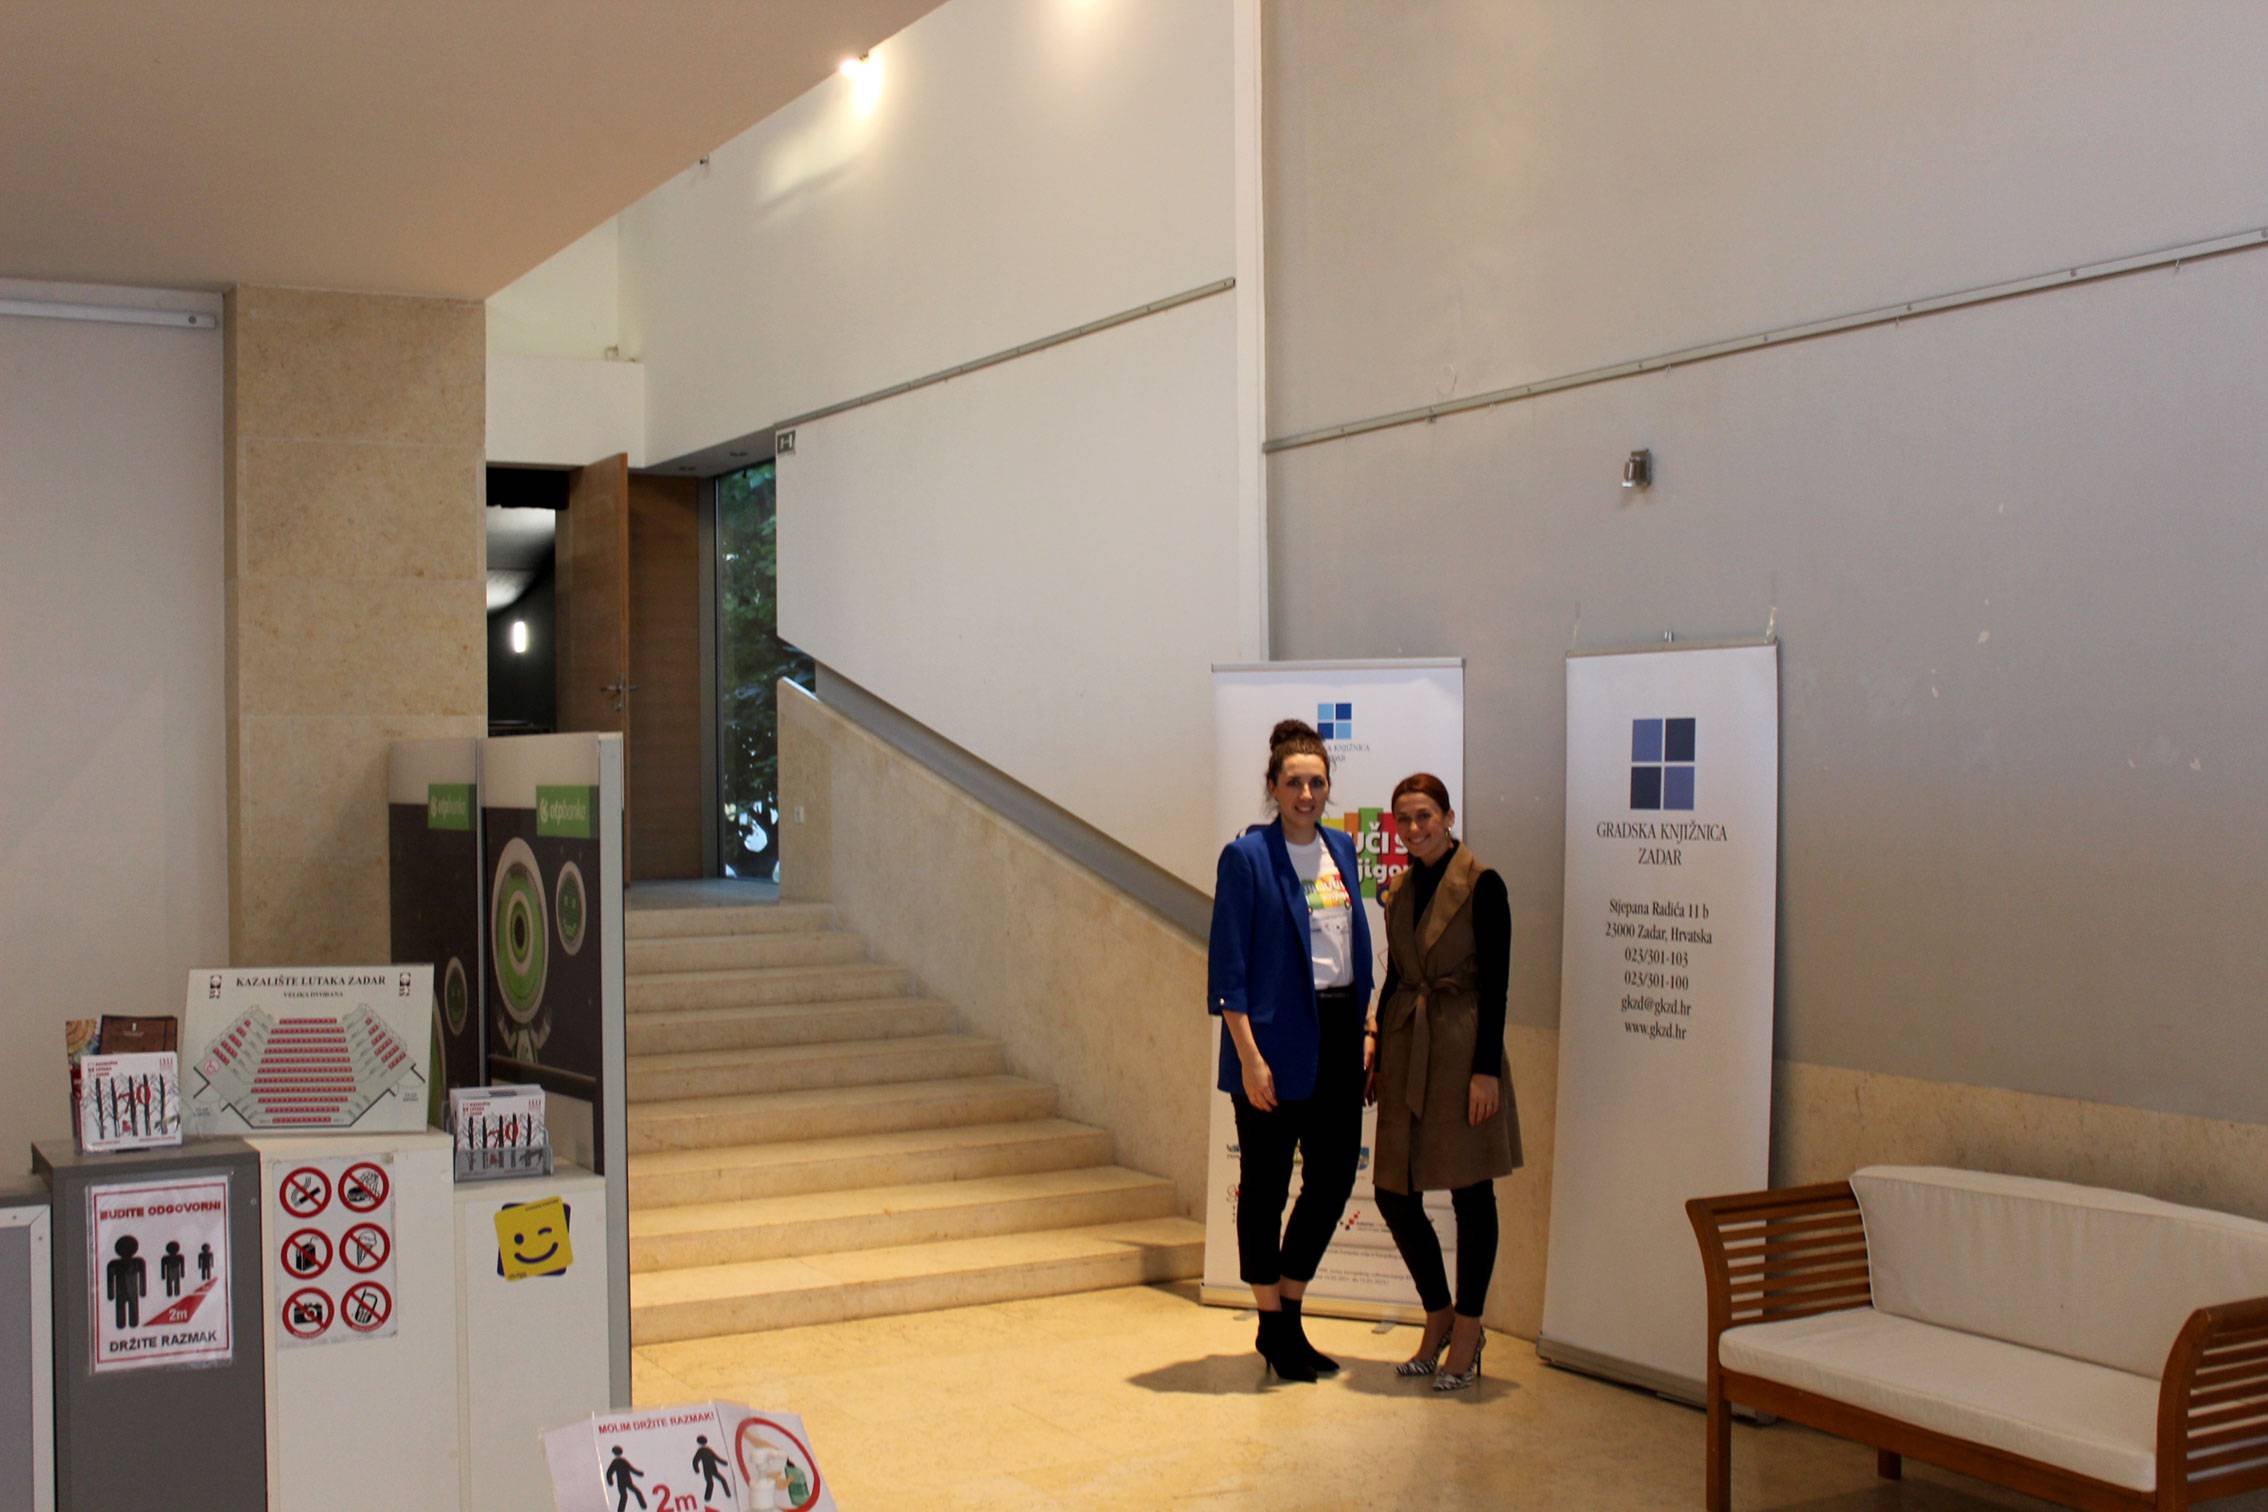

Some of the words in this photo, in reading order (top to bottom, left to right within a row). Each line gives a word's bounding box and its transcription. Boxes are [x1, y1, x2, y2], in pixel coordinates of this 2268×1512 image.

[1596, 821, 1656, 840] GRADSKA
[1660, 820, 1728, 844] KNJIŽNICA
[1637, 848, 1682, 866] ZADAR
[1609, 899, 1649, 918] Stjepana
[1652, 902, 1684, 918] Radića
[1688, 904, 1699, 919] 11
[1702, 904, 1710, 919] b
[1605, 922, 1635, 937] 23000
[1637, 925, 1668, 942] Zadar,
[1670, 926, 1713, 944] Hrvatska
[1624, 947, 1689, 968] 023/301-103
[236, 974, 298, 987] KAZALIŠTE
[300, 974, 346, 986] LUTAKA
[348, 975, 386, 986] ZADAR
[1624, 971, 1689, 990] 023/301-100
[1621, 994, 1692, 1016] gkzd@gkzd.hr
[1624, 1021, 1687, 1040] www.gkzd.hr
[100, 1206, 145, 1221] BUDITE
[147, 1201, 221, 1216] ODGOVORNI
[168, 1308, 188, 1319] 2m
[109, 1335, 158, 1353] DRŽITE
[160, 1330, 217, 1347] RAZMAK
[598, 1423, 632, 1434] MOLIM
[632, 1417, 667, 1431] DRŽITE
[669, 1411, 715, 1425] RAZMAK!
[652, 1484, 698, 1512] 2m
